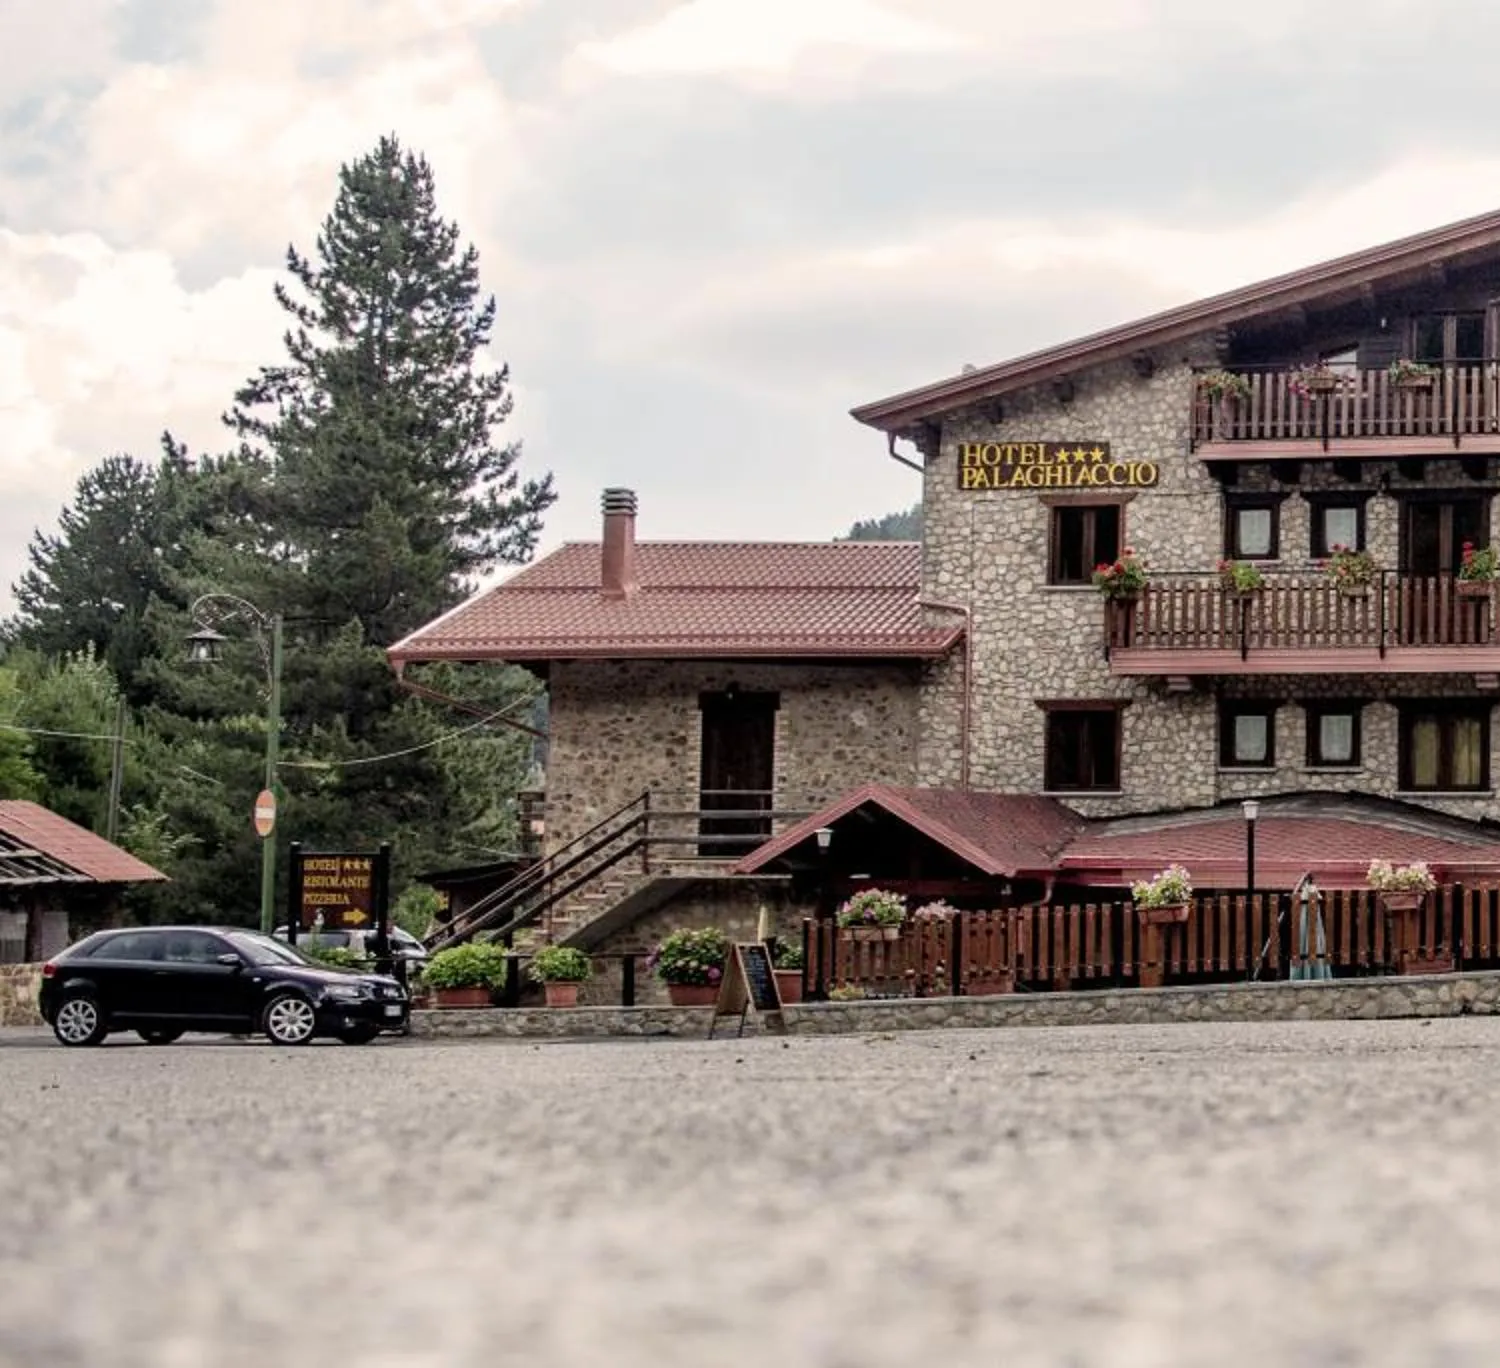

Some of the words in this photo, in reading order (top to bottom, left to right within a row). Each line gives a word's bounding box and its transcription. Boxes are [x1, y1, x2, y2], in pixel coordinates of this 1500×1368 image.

[961, 442, 1053, 467] HOTEL
[961, 463, 1157, 488] PALAGHIACCIO
[303, 859, 338, 871] HOTEL
[303, 875, 370, 888] RISTORANTE
